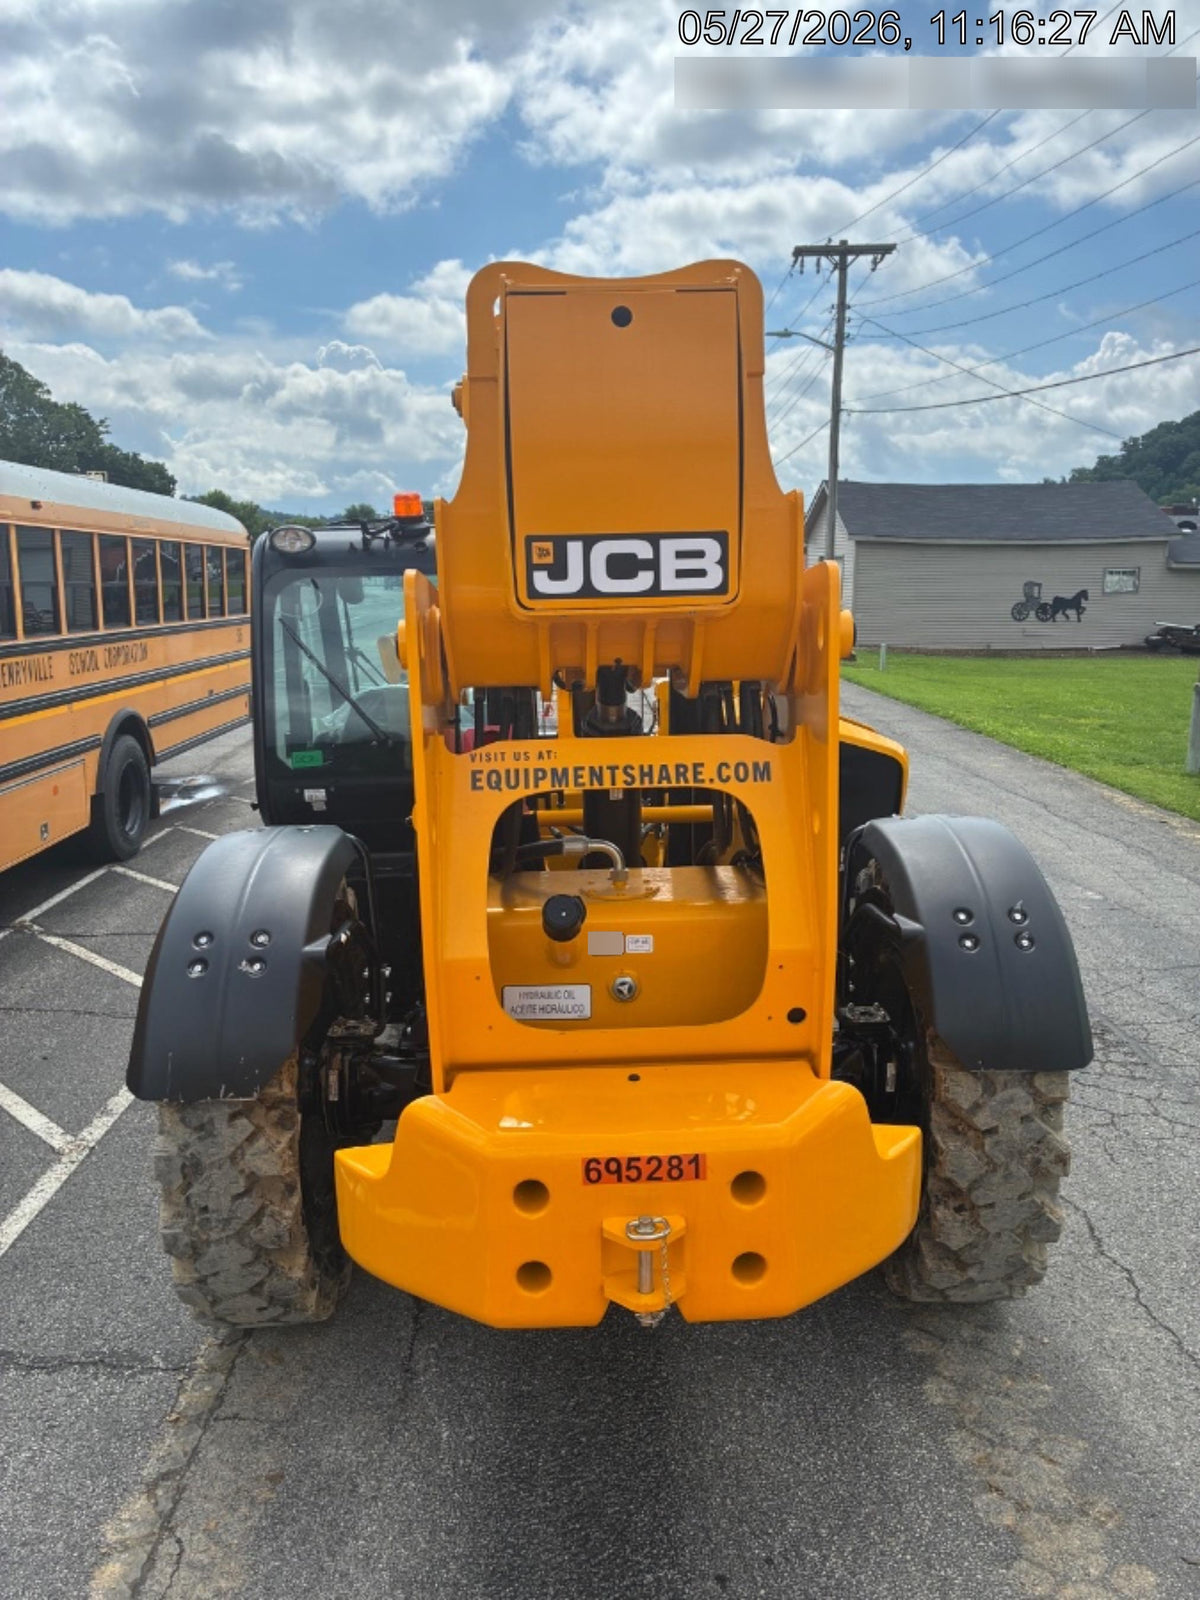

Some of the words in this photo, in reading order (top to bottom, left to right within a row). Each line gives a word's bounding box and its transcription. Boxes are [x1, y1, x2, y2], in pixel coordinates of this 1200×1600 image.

[532, 538, 723, 594] JCB
[0, 656, 53, 688] ENRYVILLE
[68, 650, 100, 675] SCHOOL
[470, 751, 507, 763] VISIT
[513, 751, 531, 762] US
[537, 750, 558, 761] AT:
[470, 761, 772, 791] EQUIPMENTSHARE.COM
[511, 1004, 538, 1015] ACEITE
[518, 990, 562, 1000] HYDRAULIC
[563, 990, 576, 1000] OIL
[584, 1153, 701, 1184] 695281
